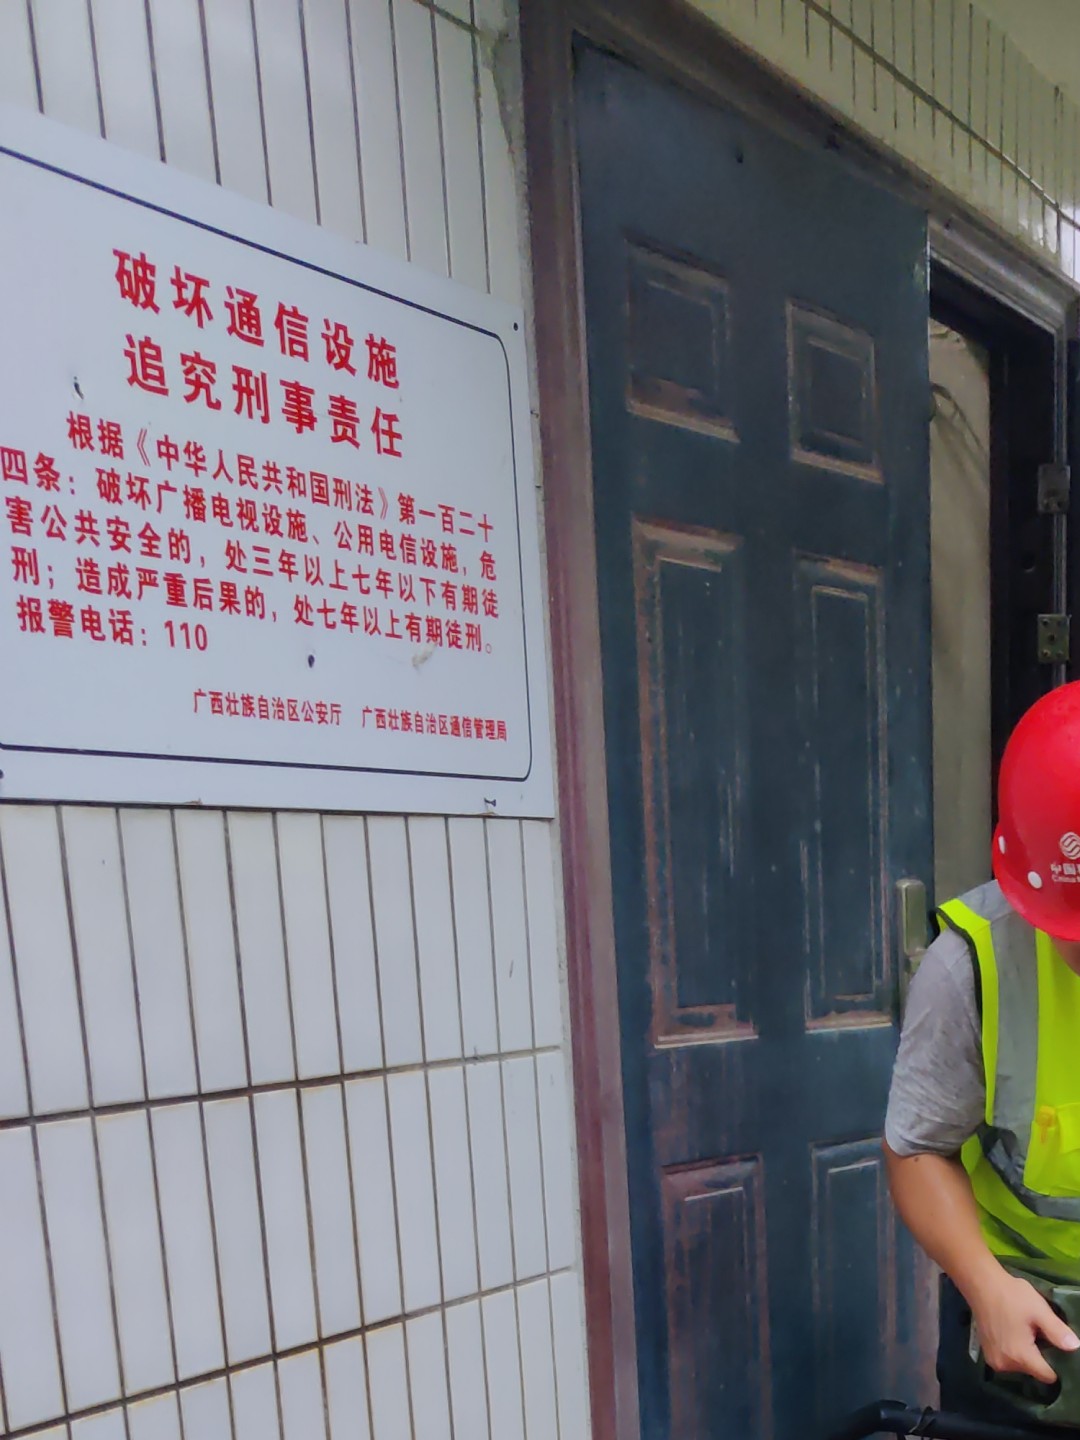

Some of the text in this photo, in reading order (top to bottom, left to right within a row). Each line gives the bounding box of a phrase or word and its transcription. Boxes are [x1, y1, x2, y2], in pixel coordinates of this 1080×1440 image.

[113, 248, 401, 389] 破坏通信设施
[125, 335, 404, 459] 追究刑事责任
[66, 410, 495, 543] 根据《中华人民共和国刑法》第一百二十
[193, 688, 508, 742] 广西壮族自治区公安厅 广西壮族自治区通信管理局
